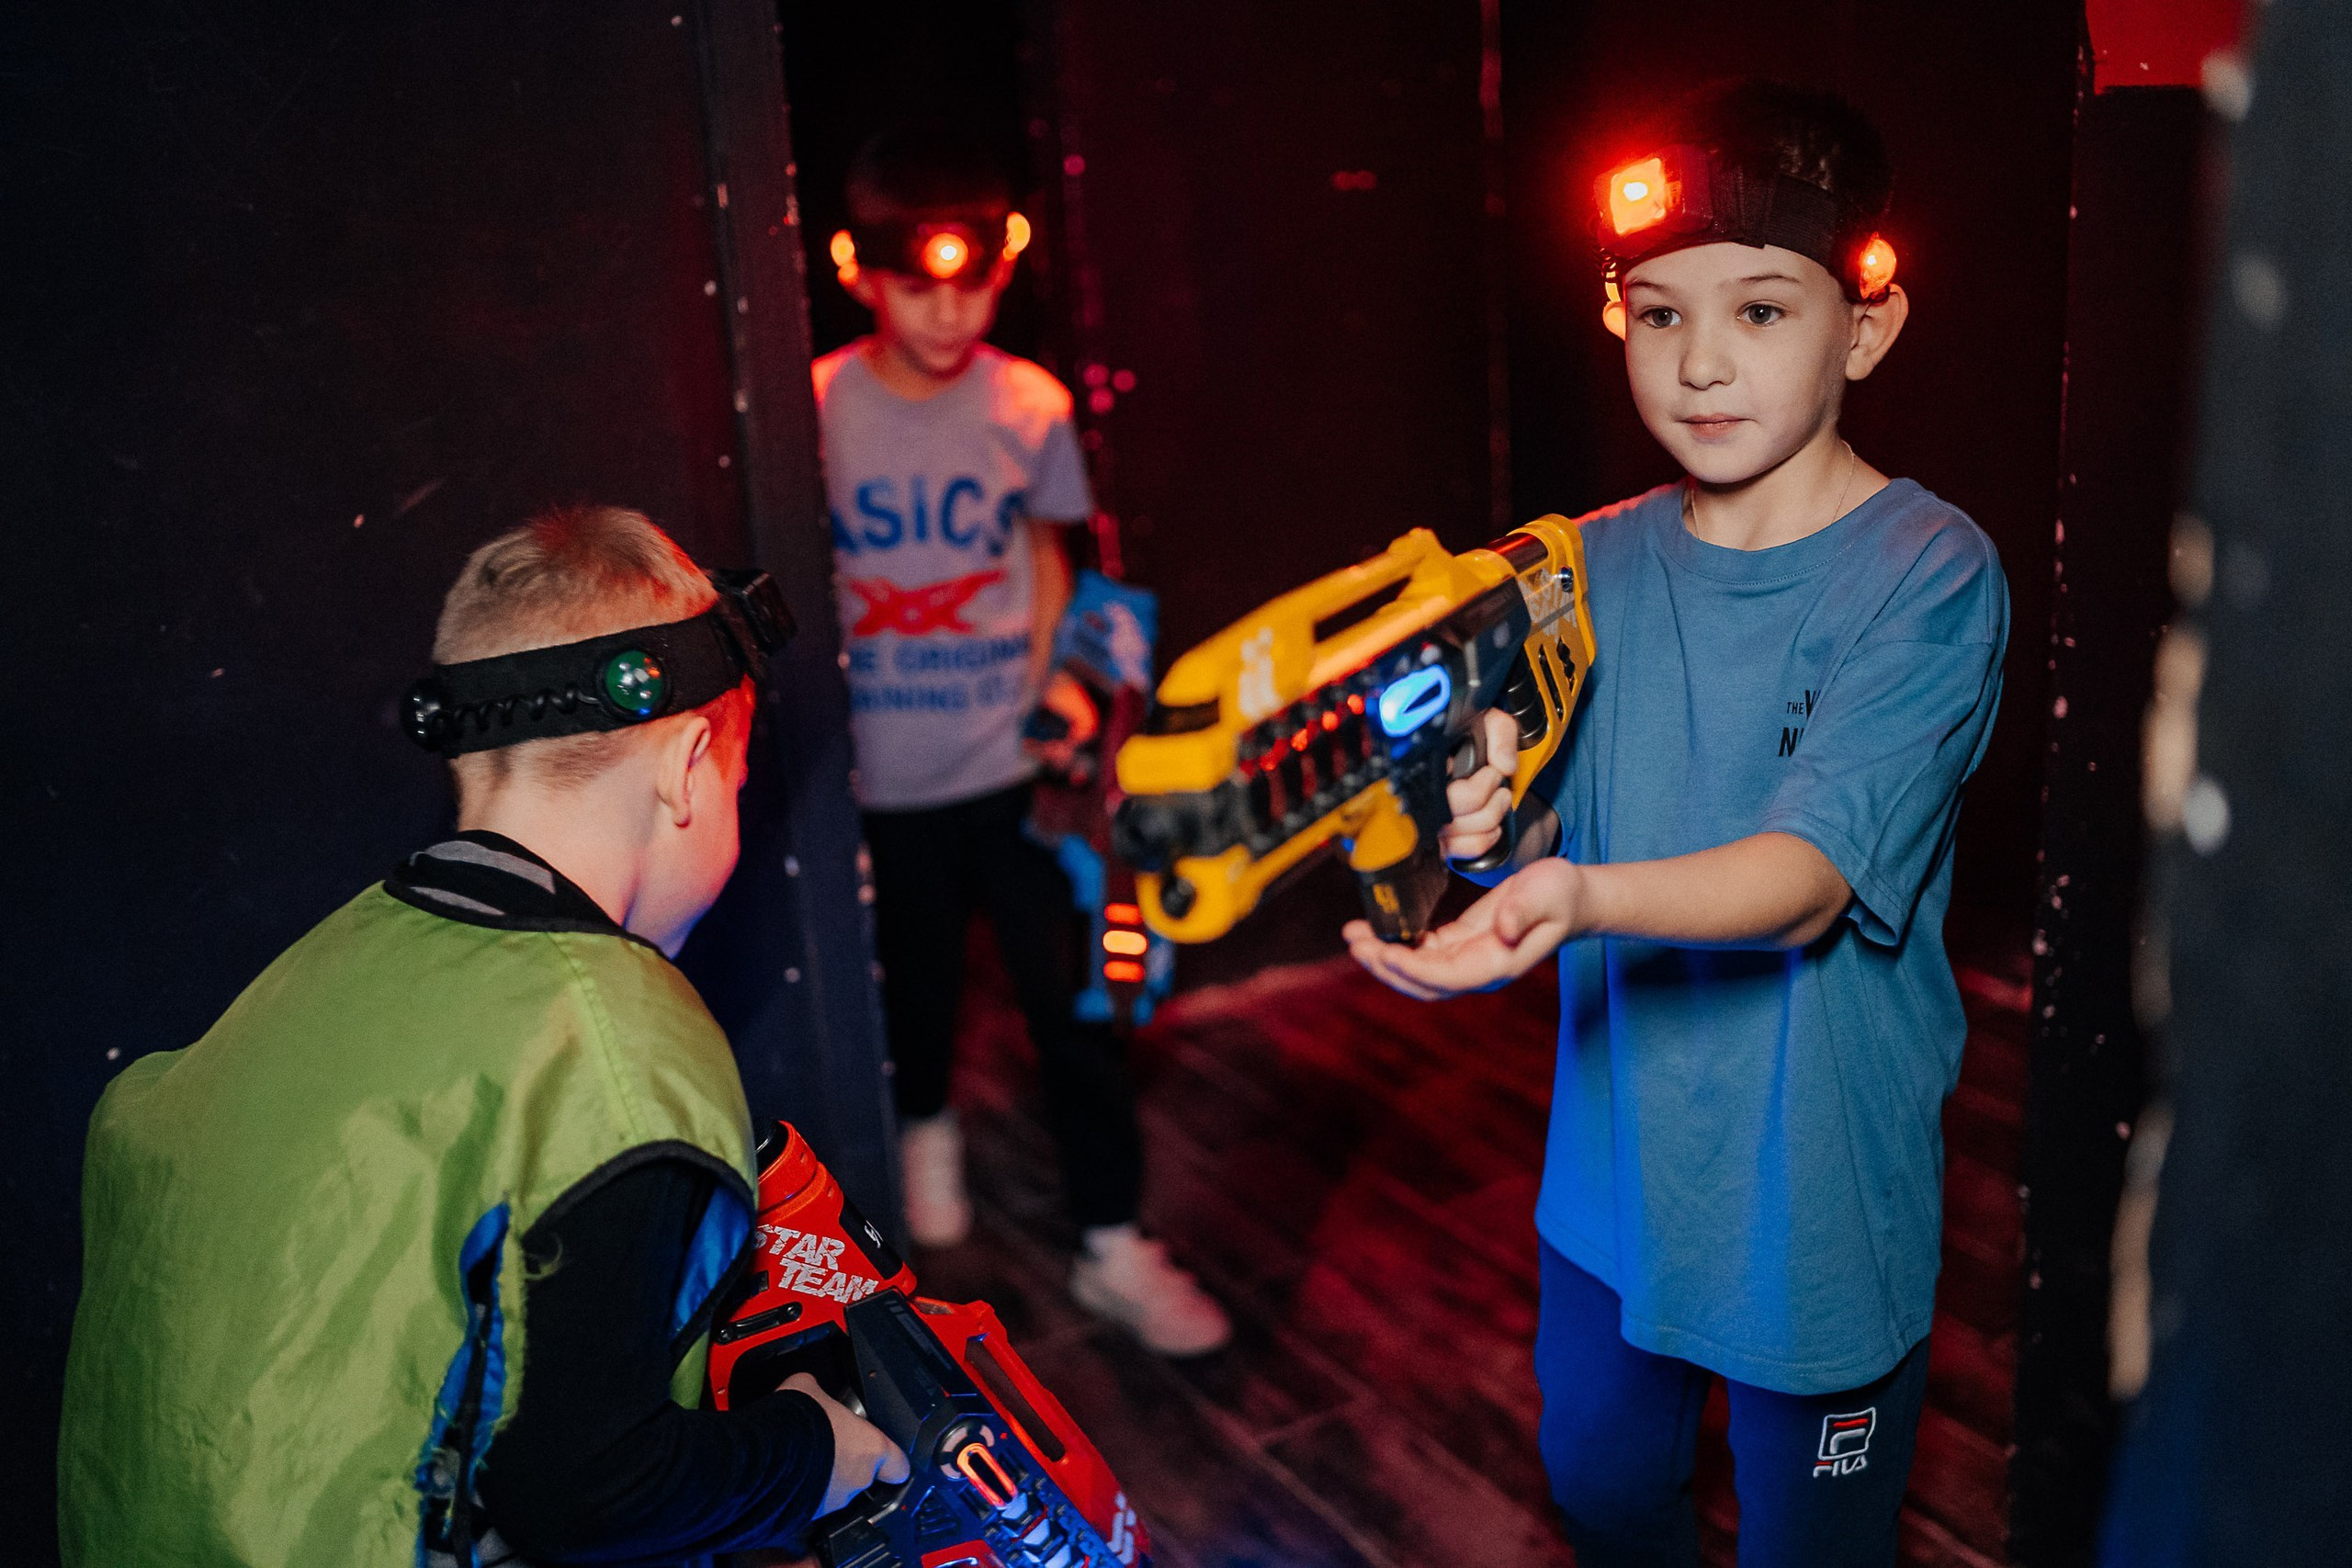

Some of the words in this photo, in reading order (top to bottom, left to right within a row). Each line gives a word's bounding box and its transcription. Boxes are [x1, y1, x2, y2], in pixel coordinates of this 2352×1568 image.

[1787, 702, 1804, 715] THE
[755, 1224, 845, 1271] STAR
[778, 1258, 878, 1304] TEAM
[1813, 1454, 1868, 1478] FILA
